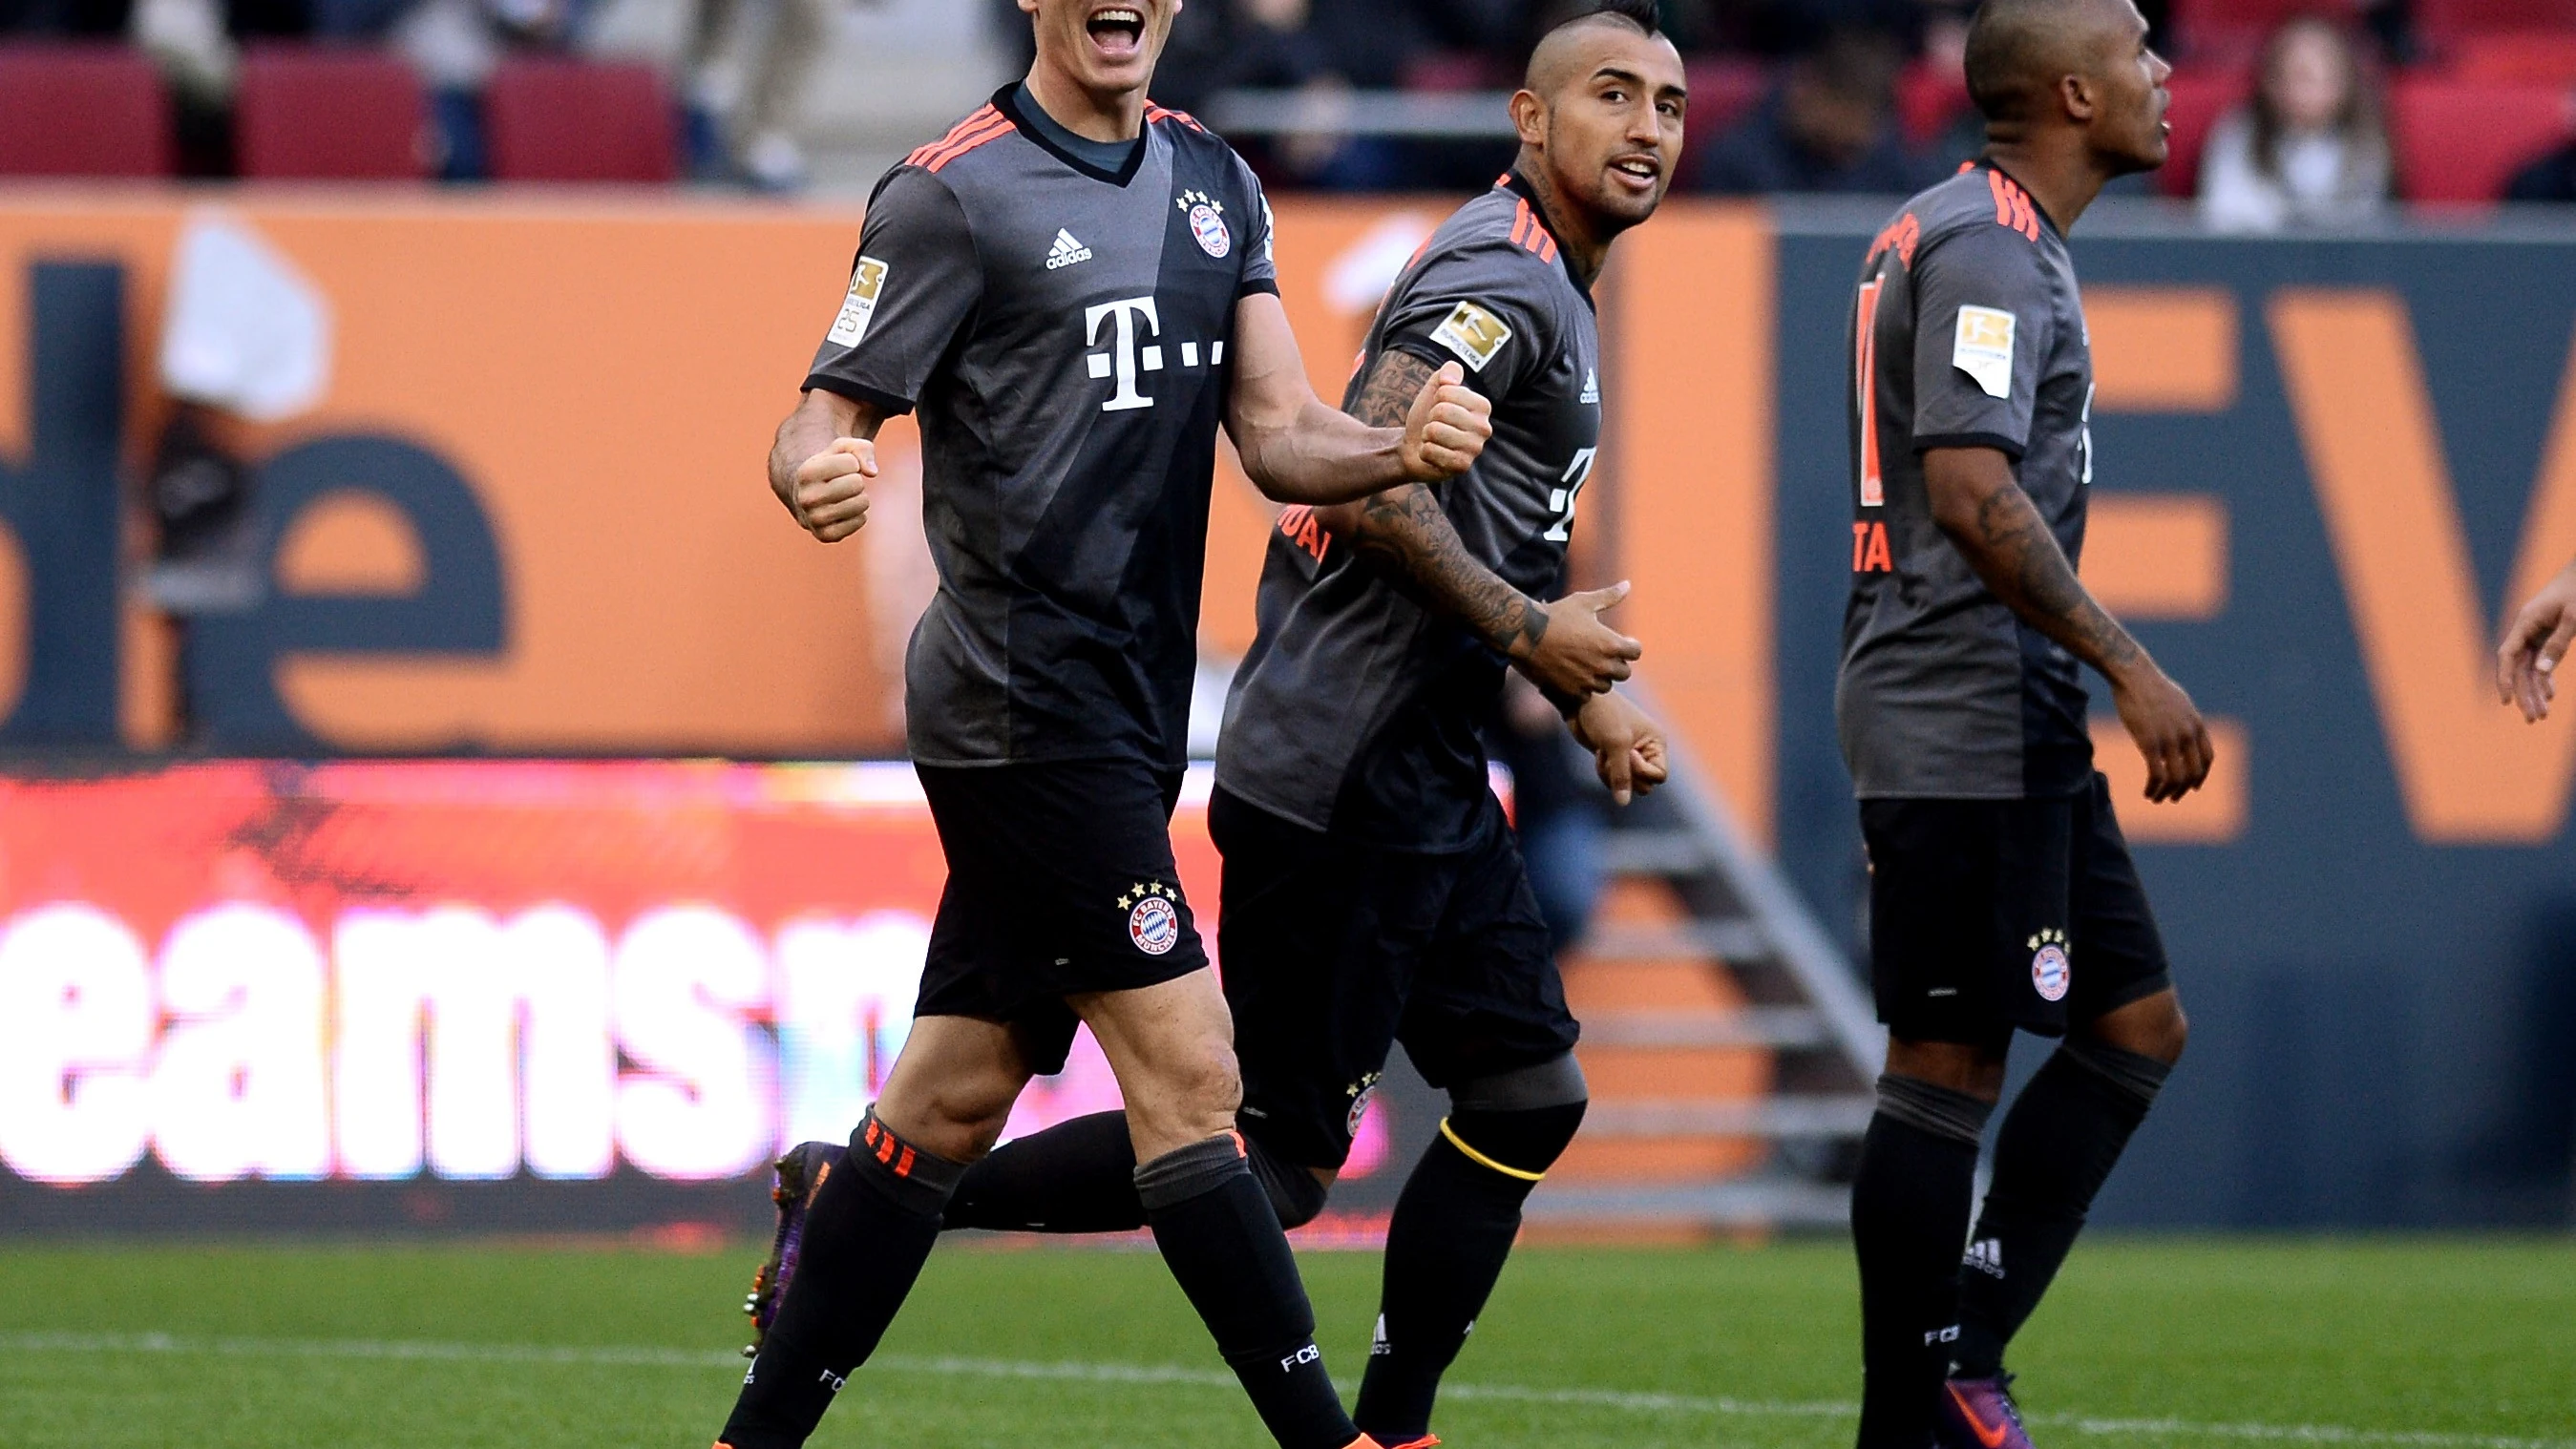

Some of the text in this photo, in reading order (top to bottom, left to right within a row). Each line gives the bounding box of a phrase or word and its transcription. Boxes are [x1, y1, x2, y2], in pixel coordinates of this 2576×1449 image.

[1045, 246, 1092, 270] adidas
[1085, 295, 1160, 411] T
[1132, 900, 1173, 927] FC BAYERN
[1280, 1344, 1320, 1373] FCB
